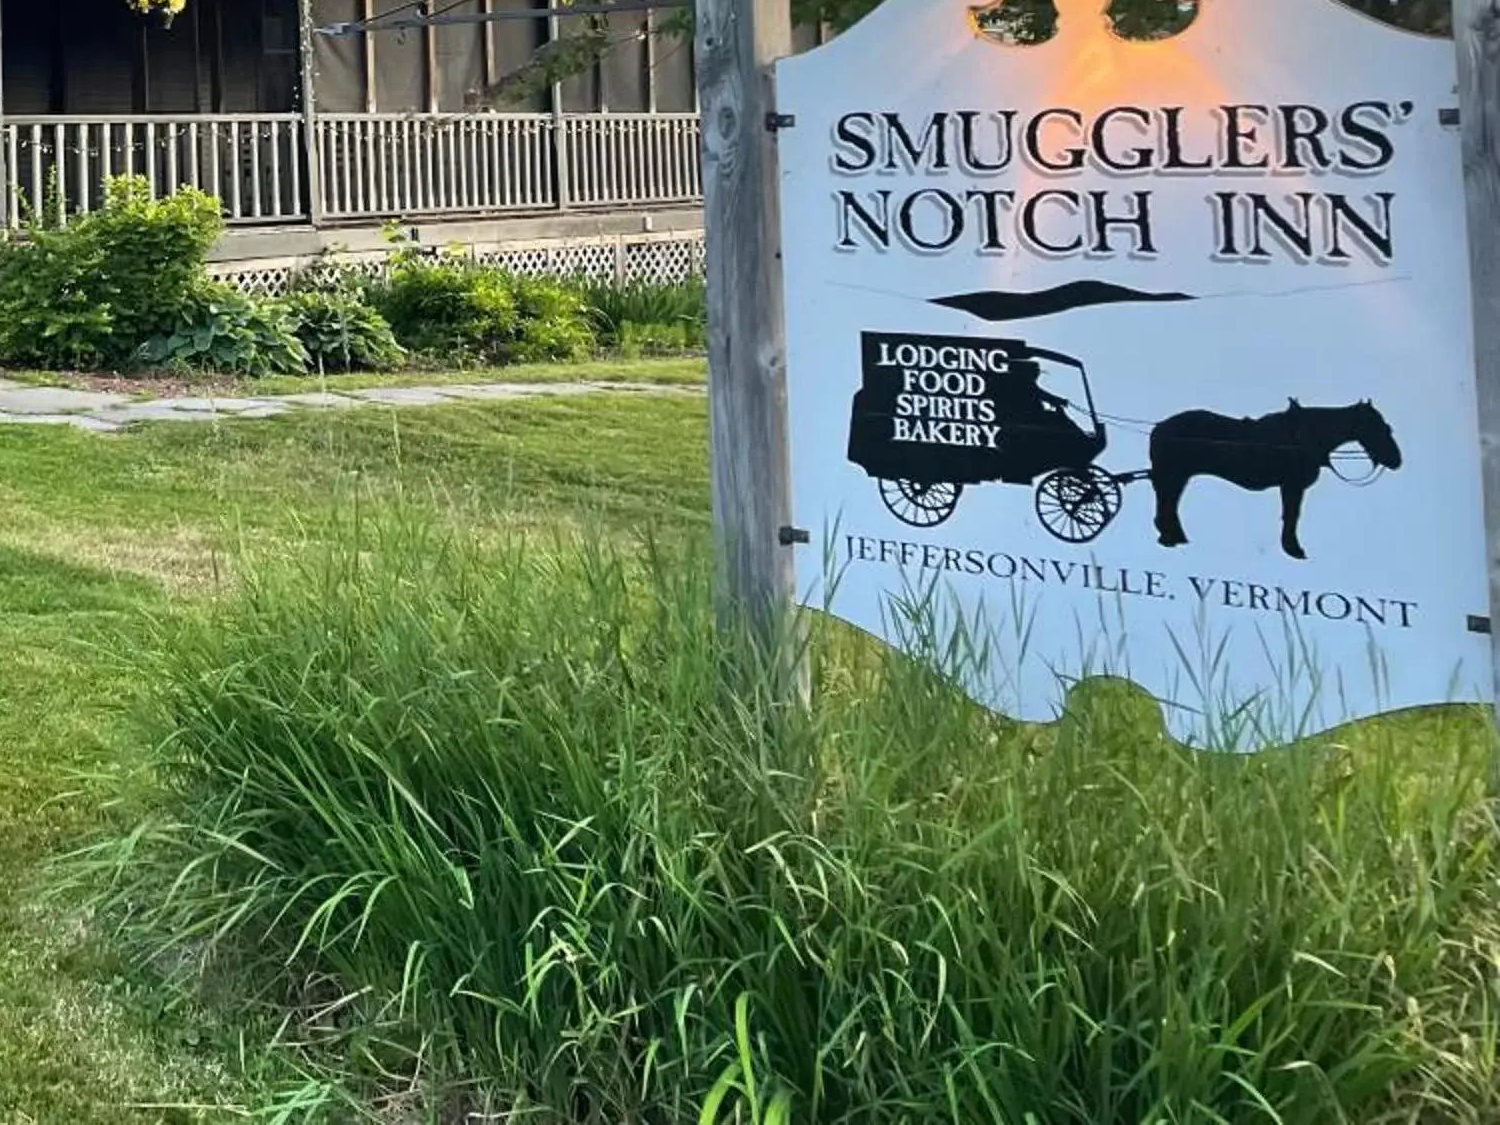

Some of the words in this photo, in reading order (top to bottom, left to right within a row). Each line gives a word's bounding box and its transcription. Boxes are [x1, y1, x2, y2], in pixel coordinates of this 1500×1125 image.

[832, 100, 1414, 175] SMUGGLERS'
[834, 188, 1157, 259] NOTCH
[1210, 190, 1396, 264] INN
[876, 342, 1009, 373] LODGING
[903, 369, 986, 397] FOOD
[896, 394, 995, 422] SPIRITS
[893, 418, 1001, 448] BAKERY
[1188, 576, 1419, 629] VERMONT
